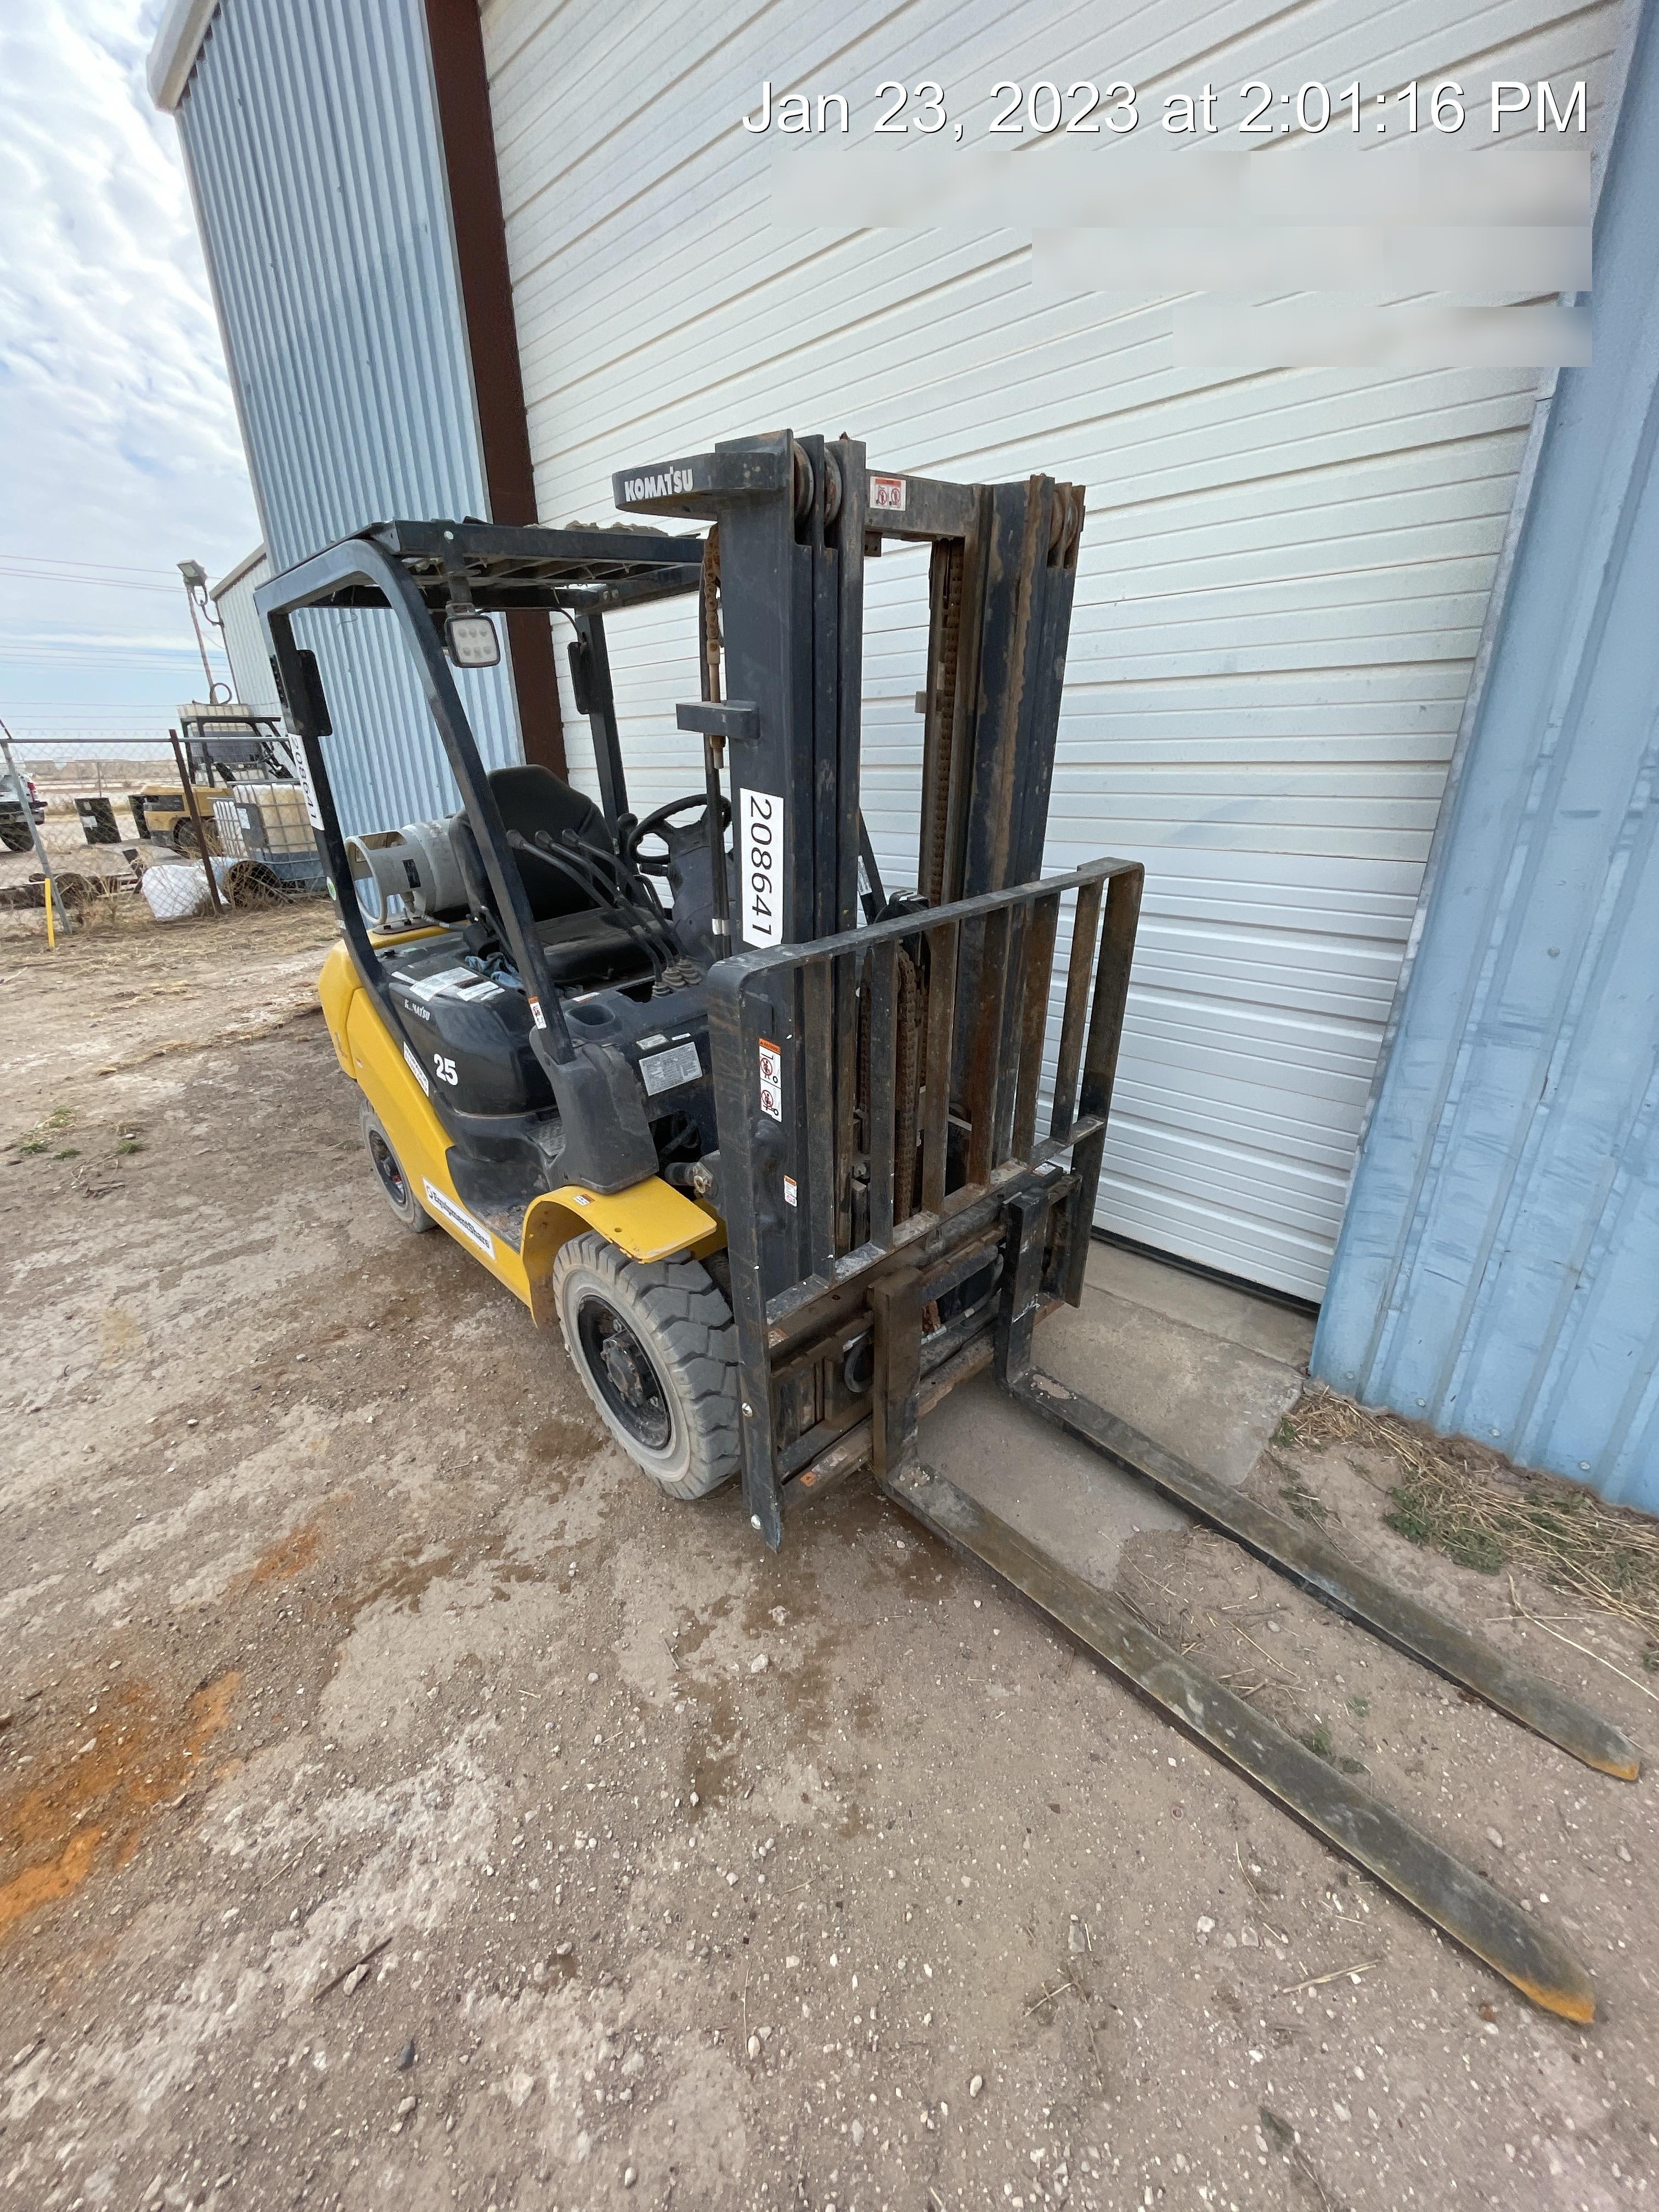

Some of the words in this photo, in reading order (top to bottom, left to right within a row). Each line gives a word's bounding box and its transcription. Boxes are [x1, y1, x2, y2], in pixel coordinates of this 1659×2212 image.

[624, 466, 693, 502] KOMATSU
[751, 795, 772, 935] 208641
[404, 998, 430, 1021] KMATSU
[433, 1053, 458, 1086] 25
